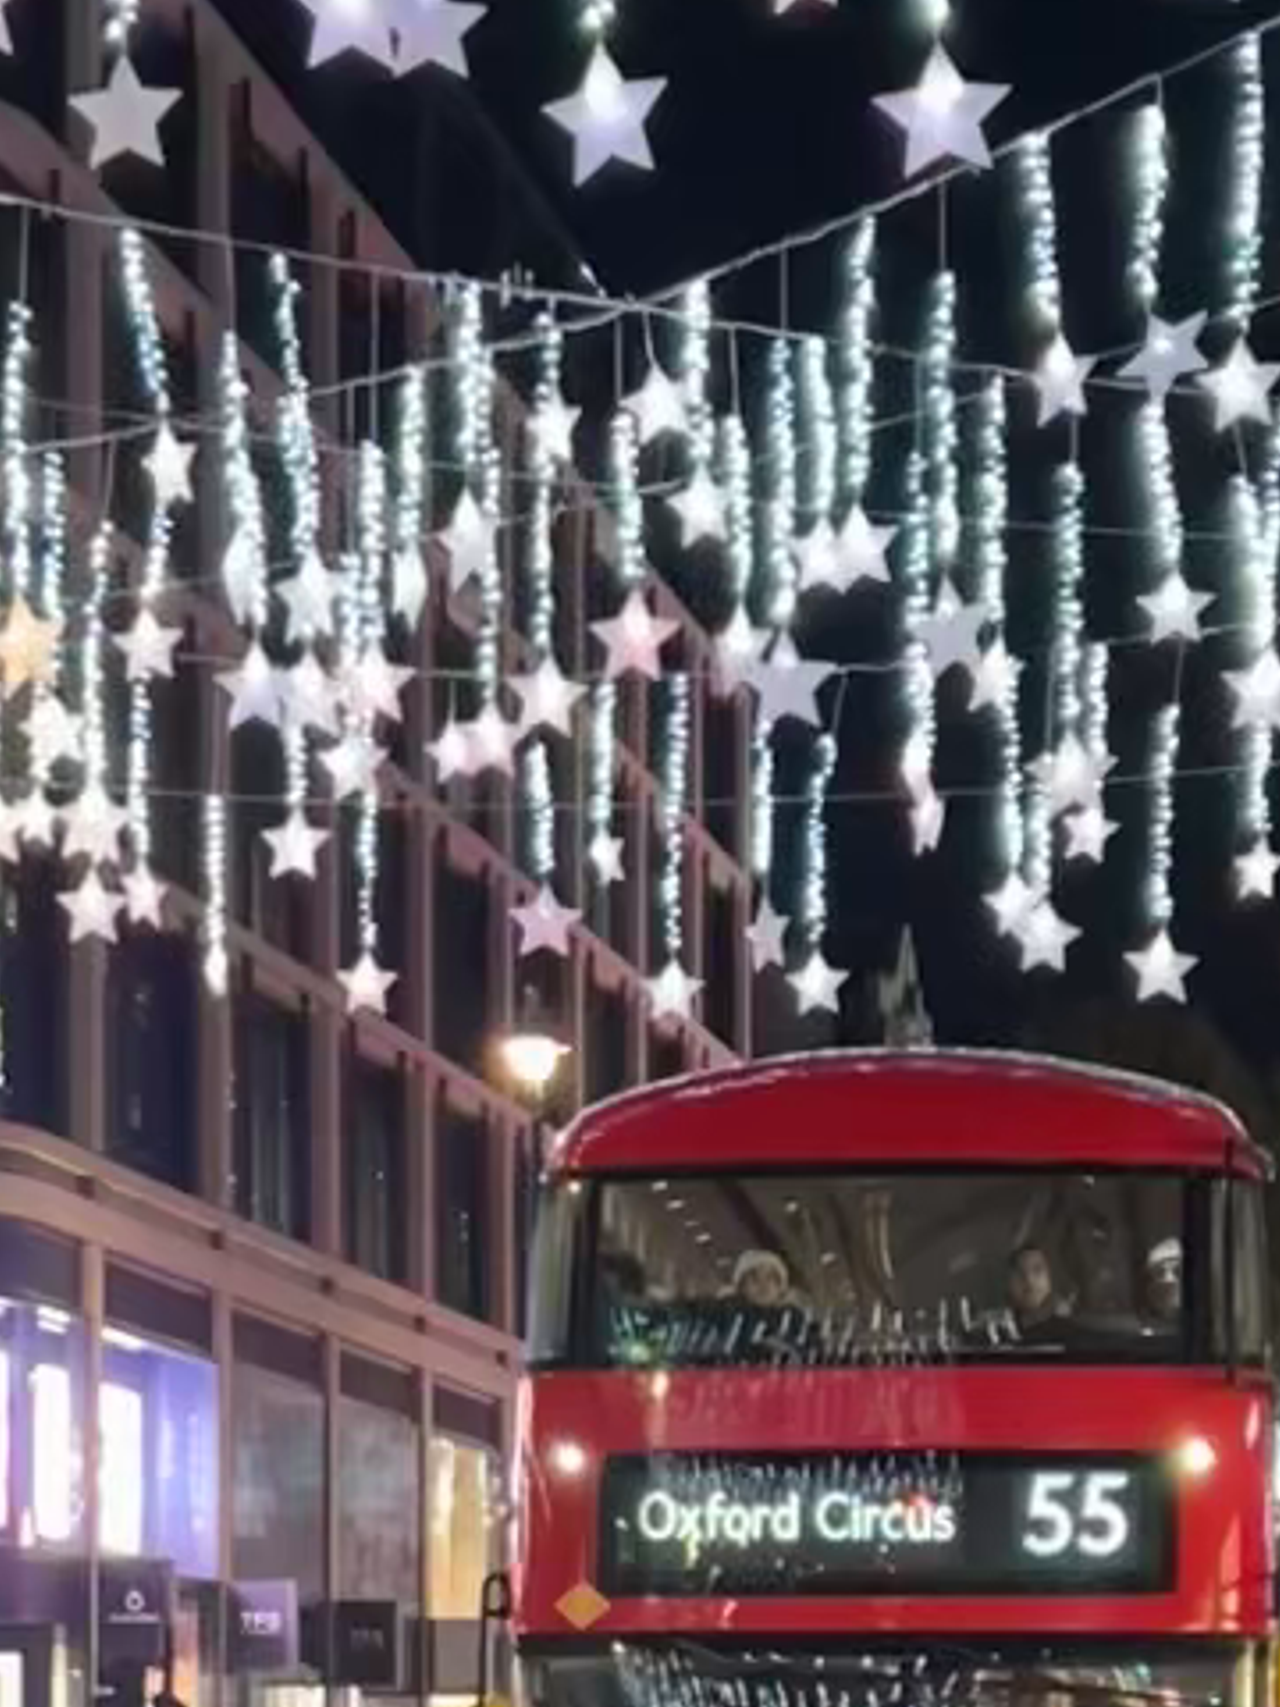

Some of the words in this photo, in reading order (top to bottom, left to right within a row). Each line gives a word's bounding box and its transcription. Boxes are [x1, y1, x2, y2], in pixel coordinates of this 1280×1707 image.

[637, 1490, 800, 1546] Oxford
[813, 1490, 957, 1542] Circus
[1020, 1471, 1130, 1557] 55
